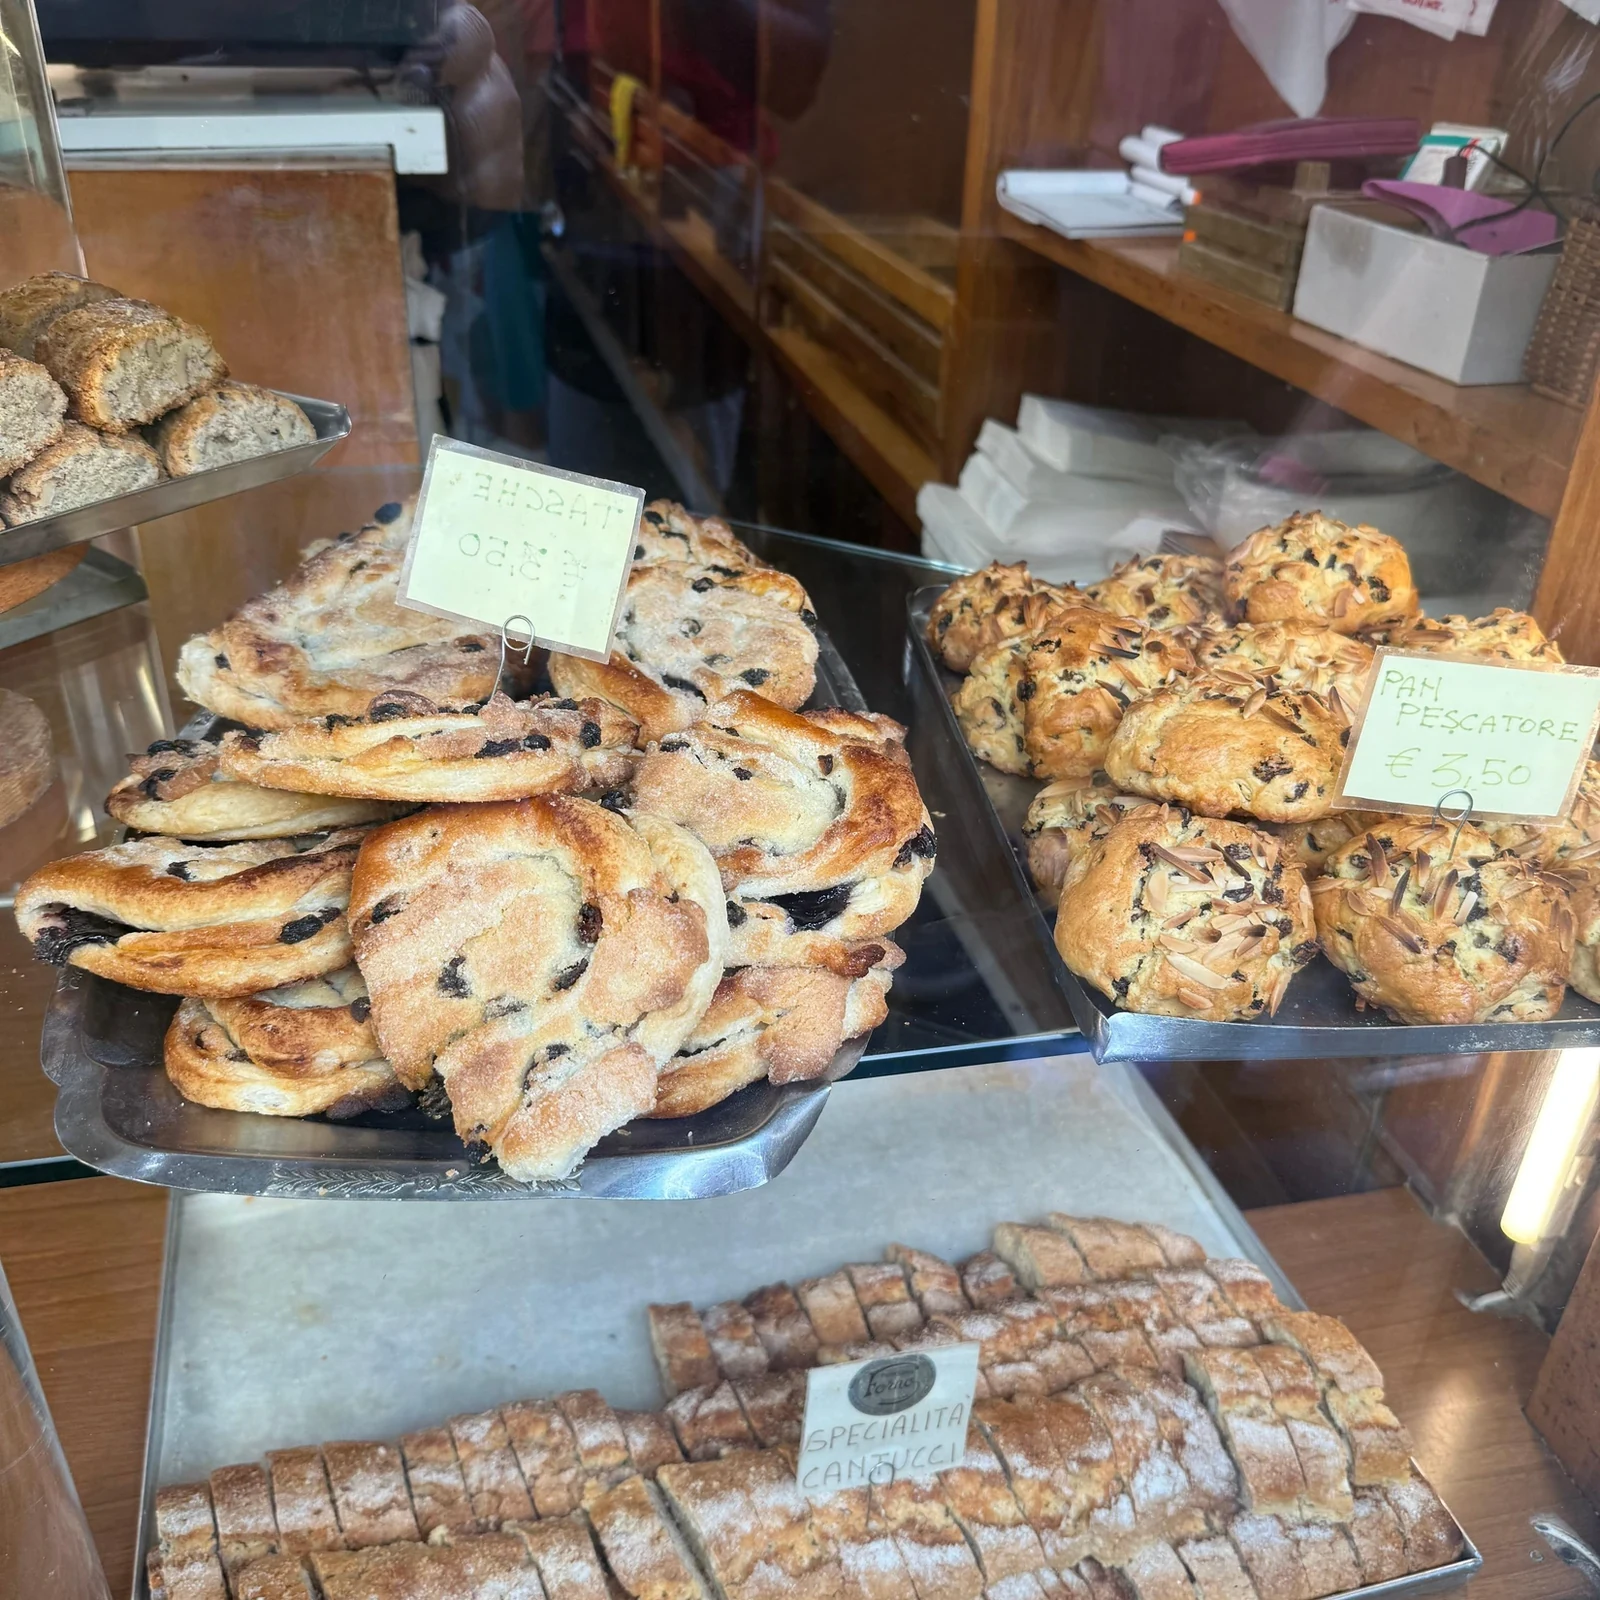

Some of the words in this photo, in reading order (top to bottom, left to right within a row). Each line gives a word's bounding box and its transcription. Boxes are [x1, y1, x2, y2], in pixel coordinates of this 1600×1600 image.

[1380, 669, 1443, 702] PAN
[1396, 702, 1580, 743] PESCATORE
[1384, 747, 1422, 779] €
[1431, 752, 1532, 789] 3,50
[801, 1441, 957, 1490] CANTUCCI
